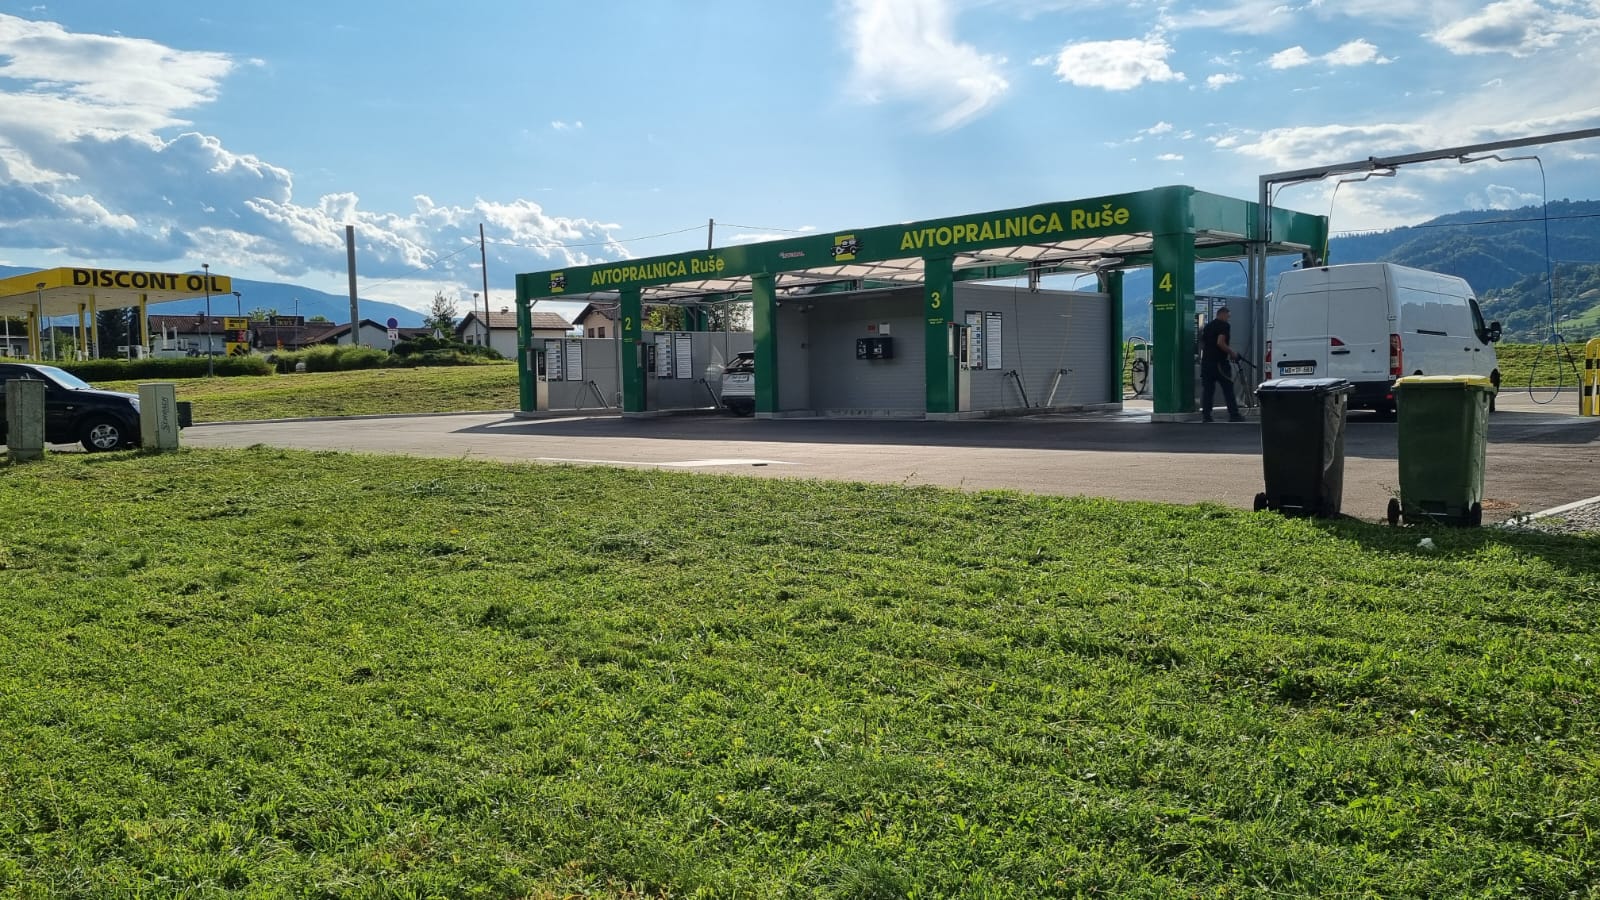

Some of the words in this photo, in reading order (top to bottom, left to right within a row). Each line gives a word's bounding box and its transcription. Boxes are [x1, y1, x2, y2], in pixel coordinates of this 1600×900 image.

[900, 211, 1064, 250] AVTOPRALNICA
[1071, 203, 1130, 230] Ruše
[72, 269, 179, 290] DISCONT
[186, 275, 223, 292] OIL
[591, 258, 687, 286] AVTOPRALNICA
[691, 255, 725, 273] Ruše
[1159, 272, 1173, 292] 4
[931, 291, 941, 309] 3
[624, 317, 633, 331] 2
